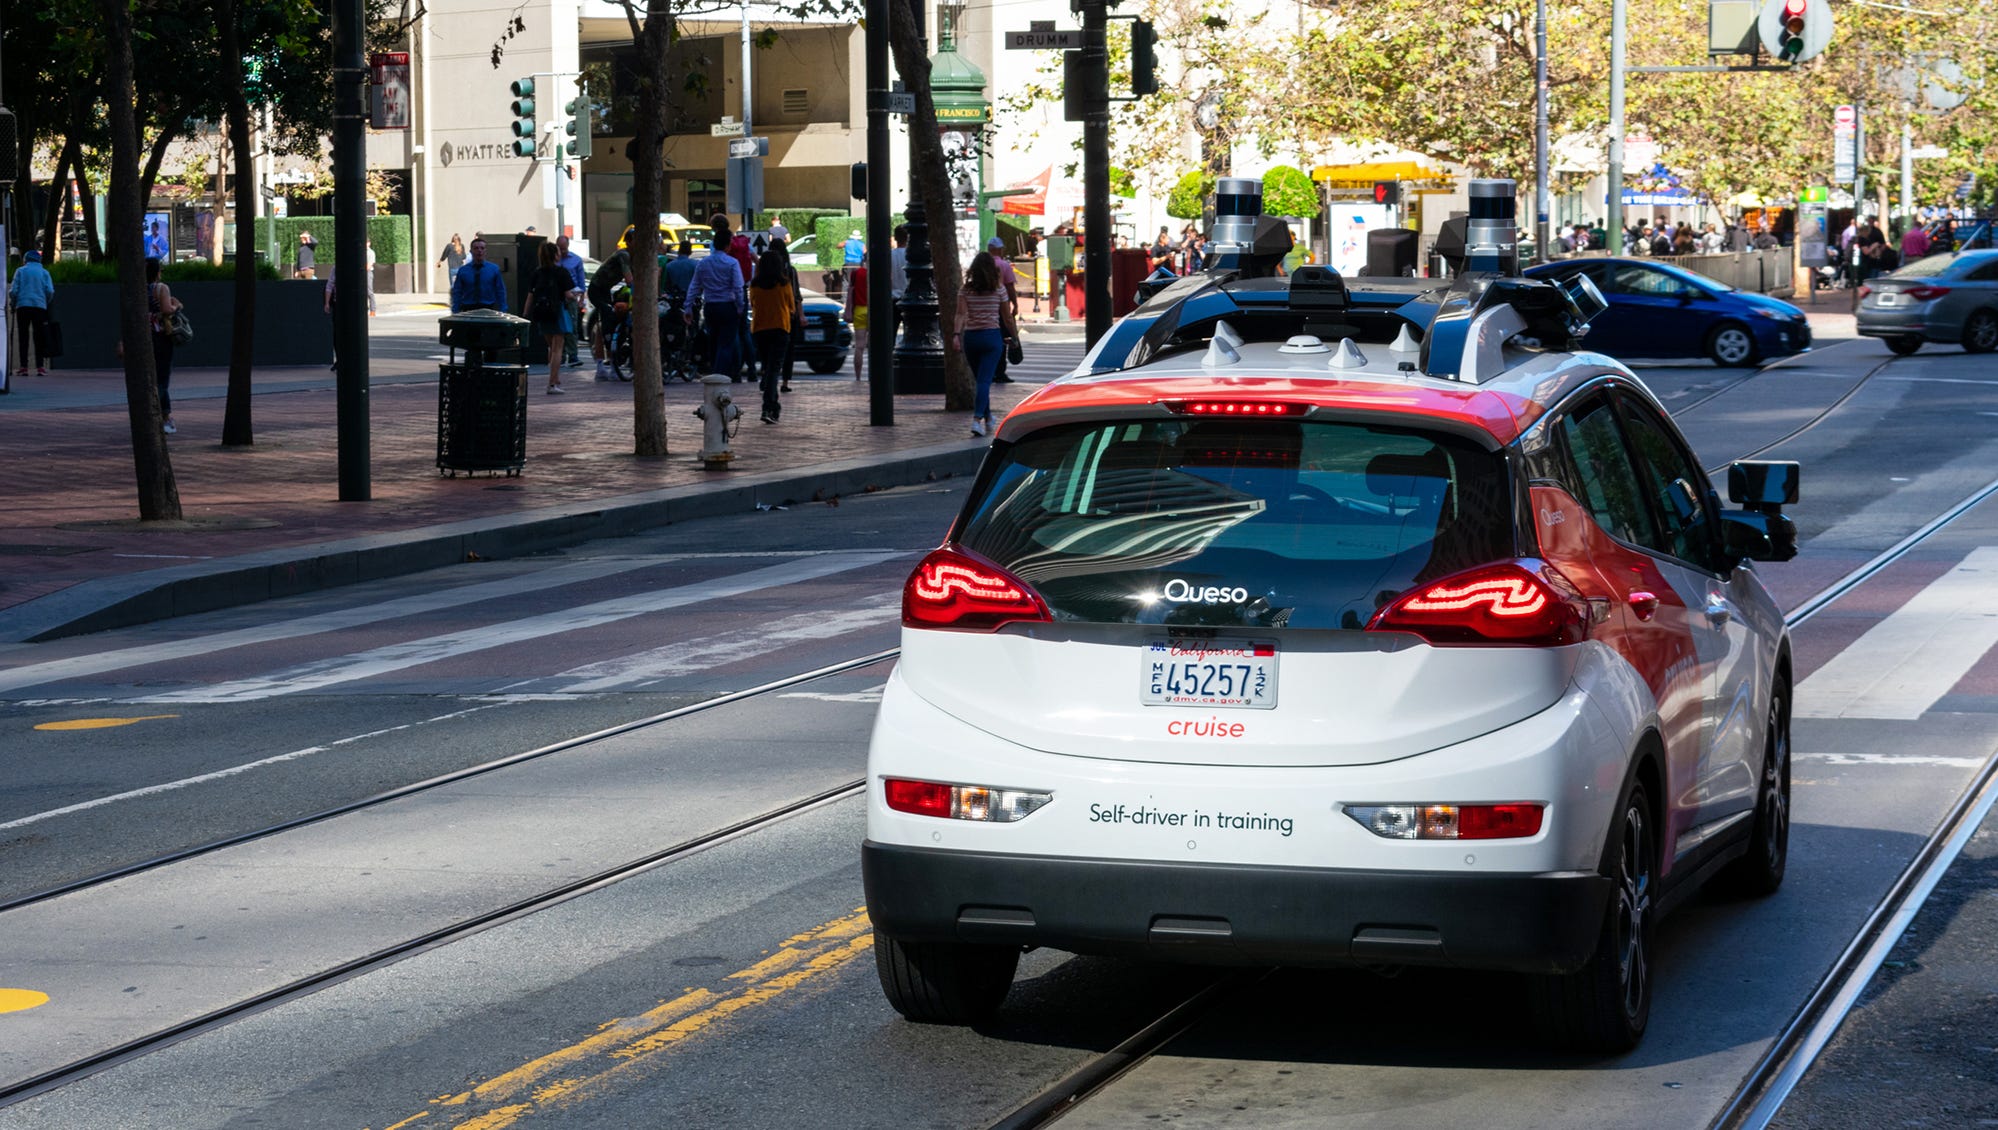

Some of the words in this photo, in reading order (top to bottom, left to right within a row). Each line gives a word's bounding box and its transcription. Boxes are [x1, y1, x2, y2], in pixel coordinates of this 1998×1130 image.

[1016, 34, 1068, 46] DRUMM
[939, 108, 980, 118] FRANCISCO
[457, 144, 494, 160] HYATT
[1541, 508, 1566, 527] Queso
[1164, 578, 1248, 603] Queso
[1151, 641, 1166, 652] JUL
[1170, 640, 1254, 661] California
[1166, 663, 1251, 697] 45257
[1173, 695, 1242, 705] dmv.ca.gov
[1167, 716, 1245, 738] cruise
[1089, 803, 1188, 827] Self-driver
[1193, 809, 1210, 828] in
[1217, 811, 1294, 837] training
